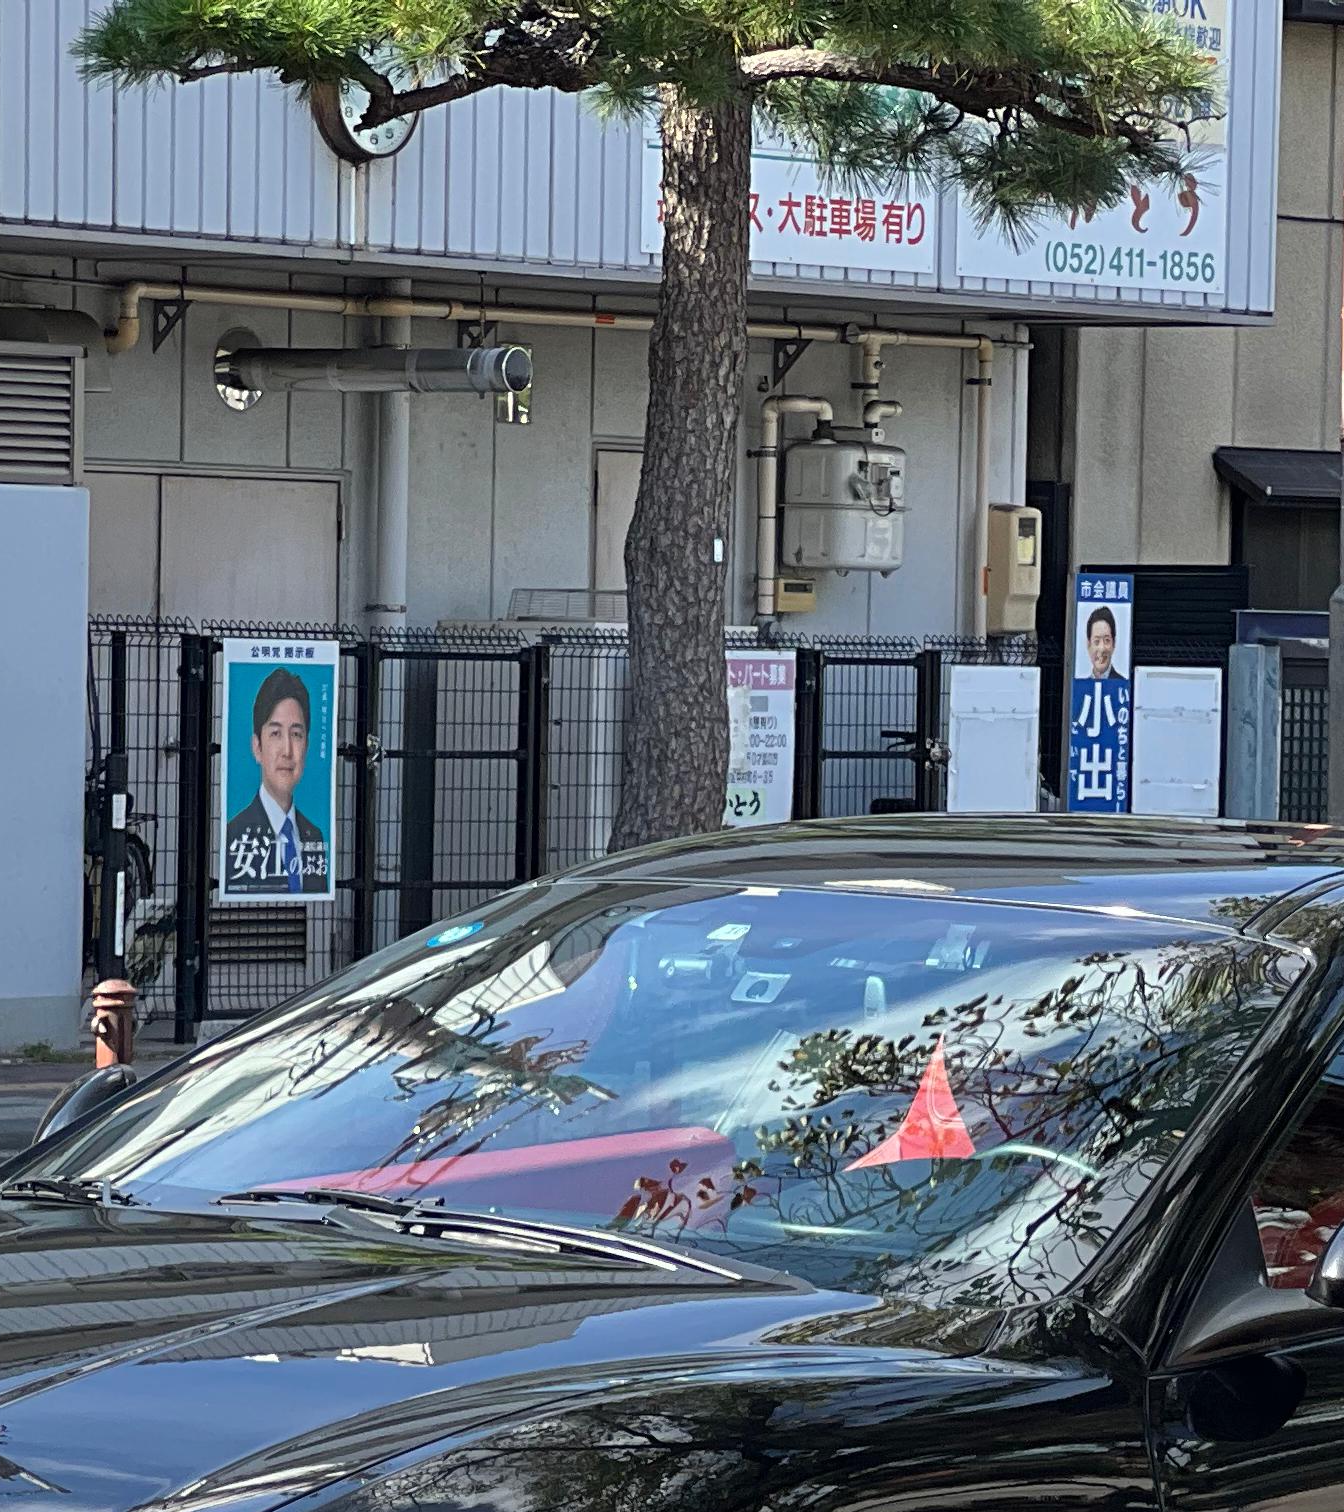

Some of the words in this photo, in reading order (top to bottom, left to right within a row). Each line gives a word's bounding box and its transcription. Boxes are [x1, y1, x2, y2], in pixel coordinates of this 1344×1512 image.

[345, 106, 353, 118] 8
[370, 134, 379, 145] 6
[386, 128, 394, 139] 5
[1069, 173, 1200, 237] とう
[1080, 580, 1129, 600] 市会議員
[1078, 682, 1117, 800] 小出
[729, 790, 761, 817] とう
